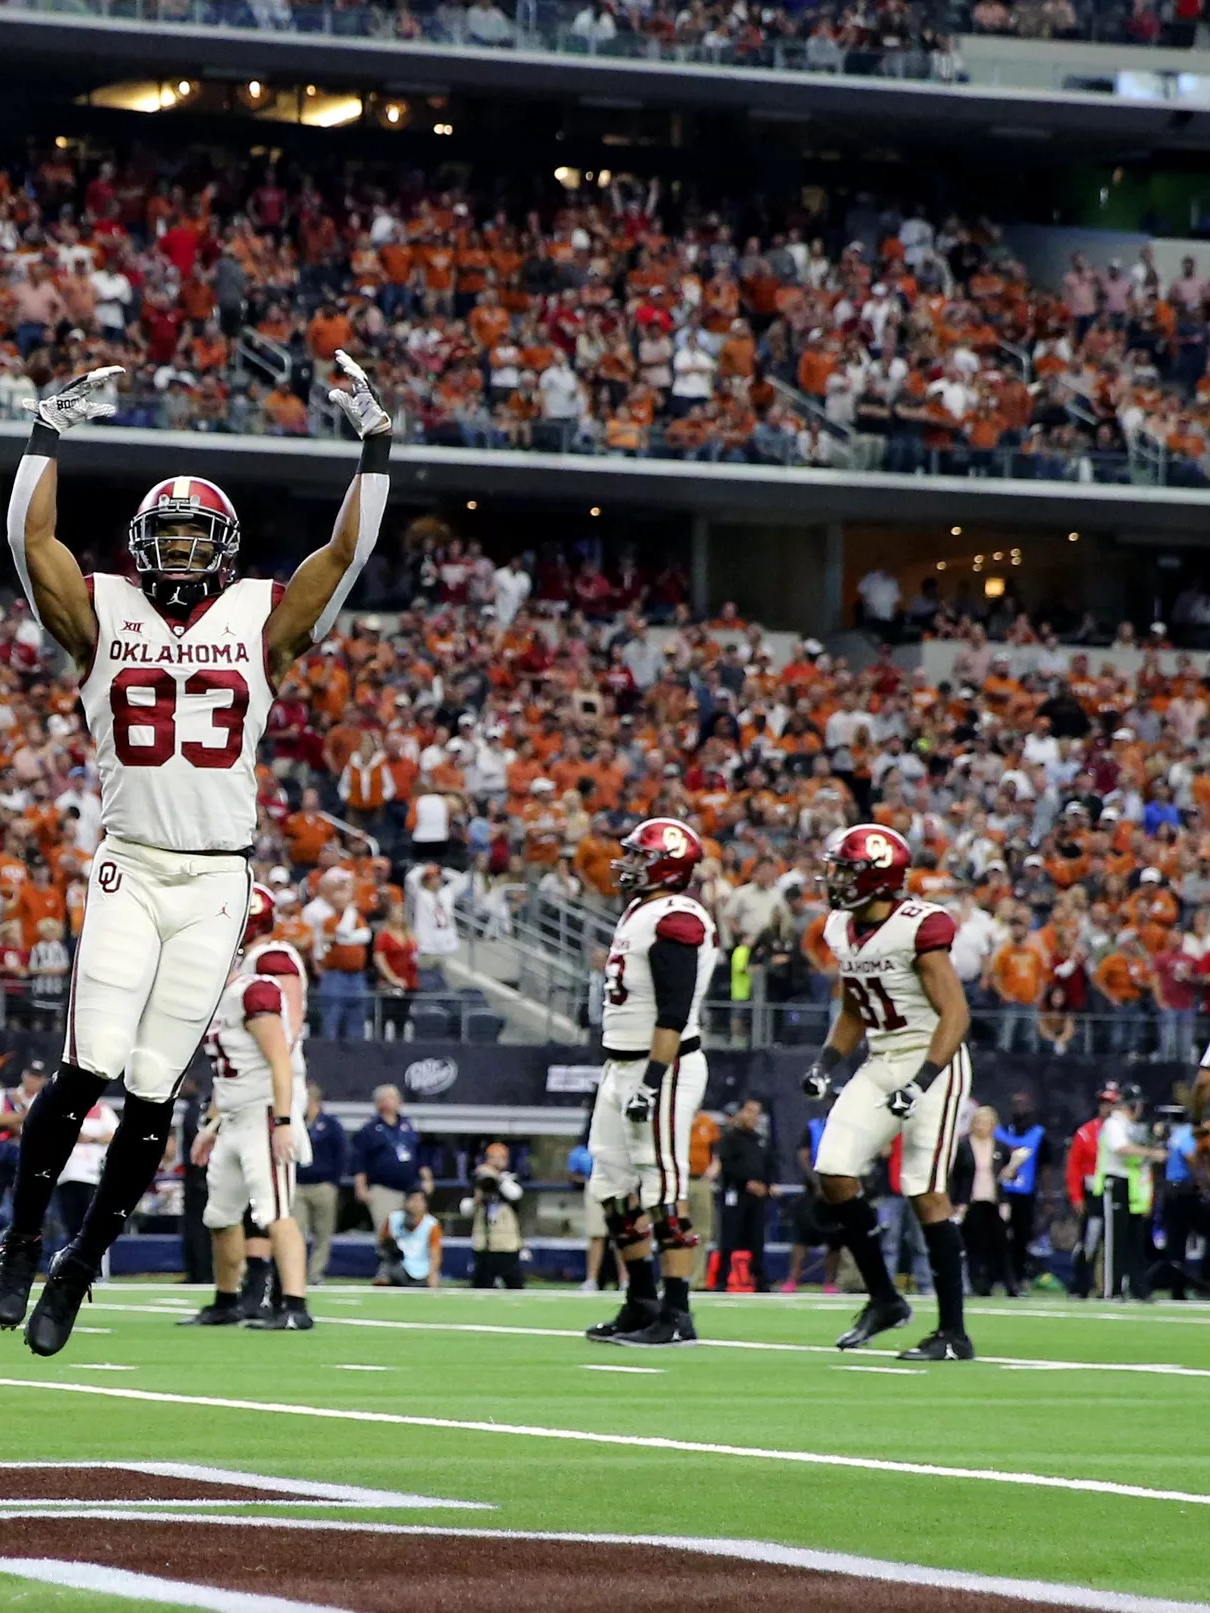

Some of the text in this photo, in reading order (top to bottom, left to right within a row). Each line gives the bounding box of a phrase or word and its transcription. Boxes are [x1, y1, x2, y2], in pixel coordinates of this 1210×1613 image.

[109, 639, 250, 664] OKLAHOMA
[109, 667, 250, 769] 83
[98, 861, 123, 893] OU
